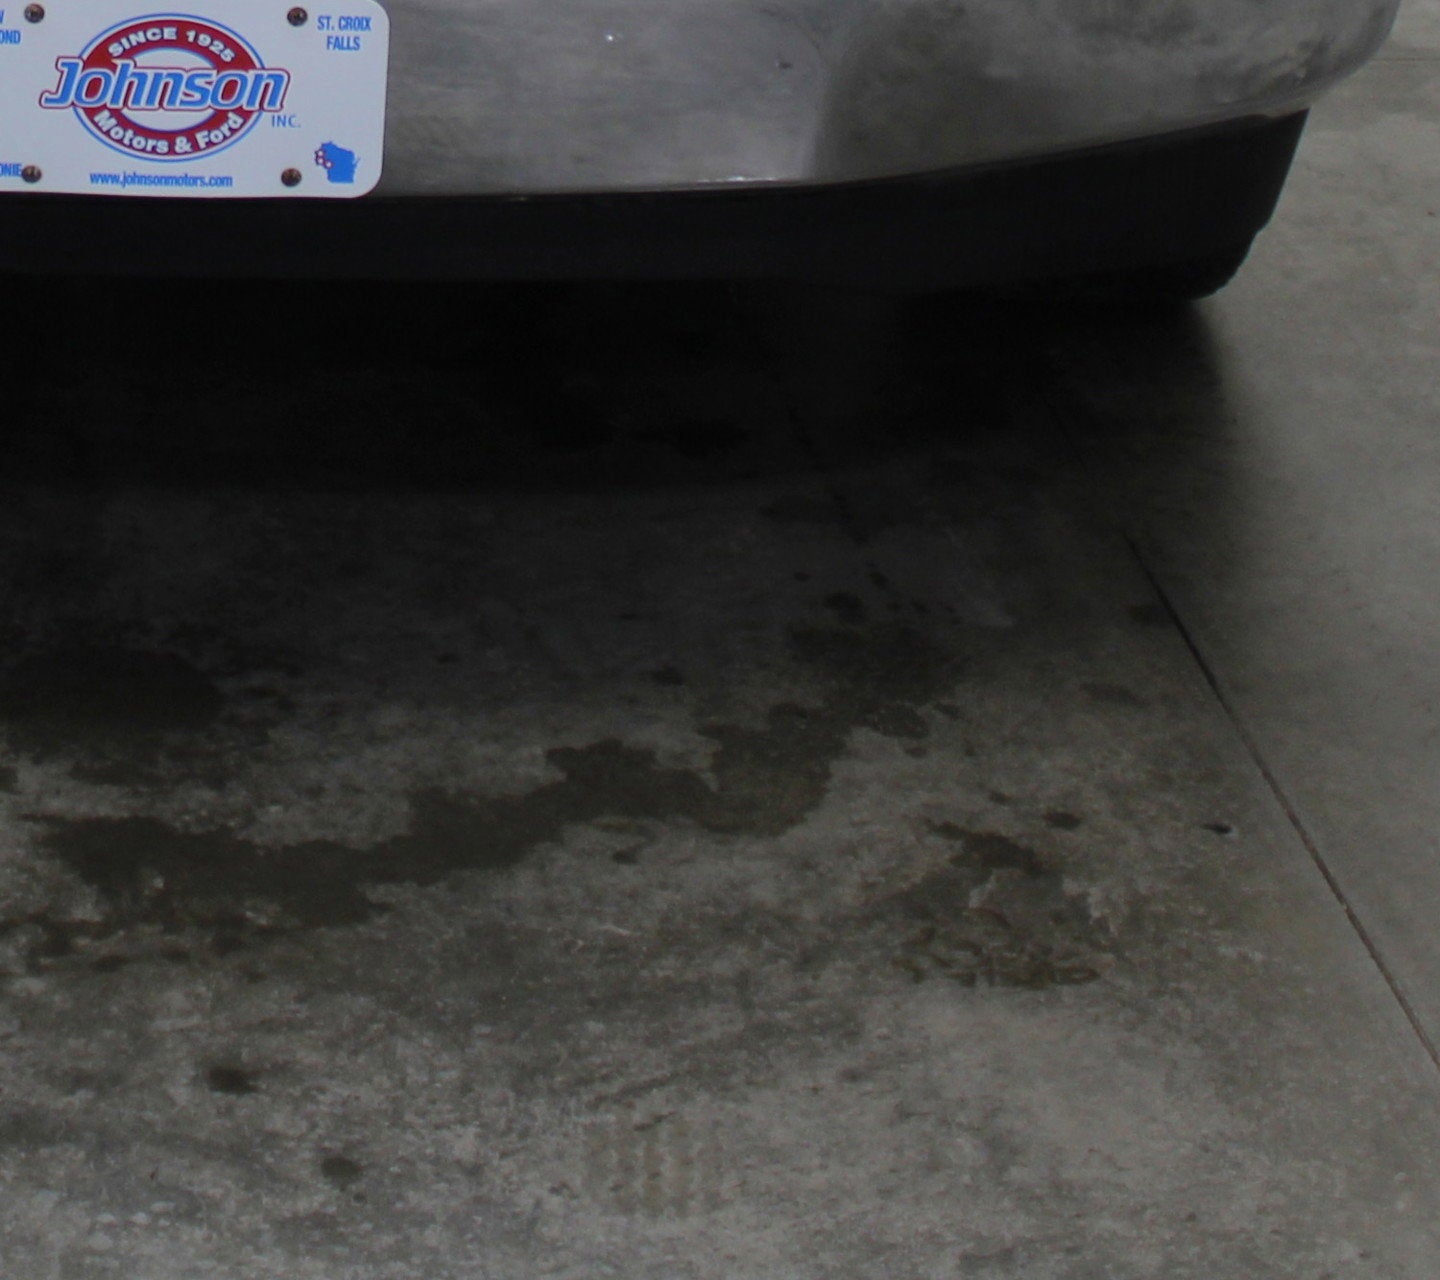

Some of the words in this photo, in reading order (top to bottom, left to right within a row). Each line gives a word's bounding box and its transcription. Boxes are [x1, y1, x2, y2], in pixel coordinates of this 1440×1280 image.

[317, 15, 335, 31] ST.
[338, 16, 372, 32] CROIX
[107, 26, 178, 58] SINCE
[185, 29, 236, 63] 1925
[326, 35, 361, 51] FALLS
[41, 58, 288, 111] Johnson
[271, 115, 302, 129] INC.
[93, 109, 170, 155] Motors
[173, 136, 193, 154] &
[194, 112, 245, 150] Ford
[89, 170, 234, 188] www.johnsonmotors.com
